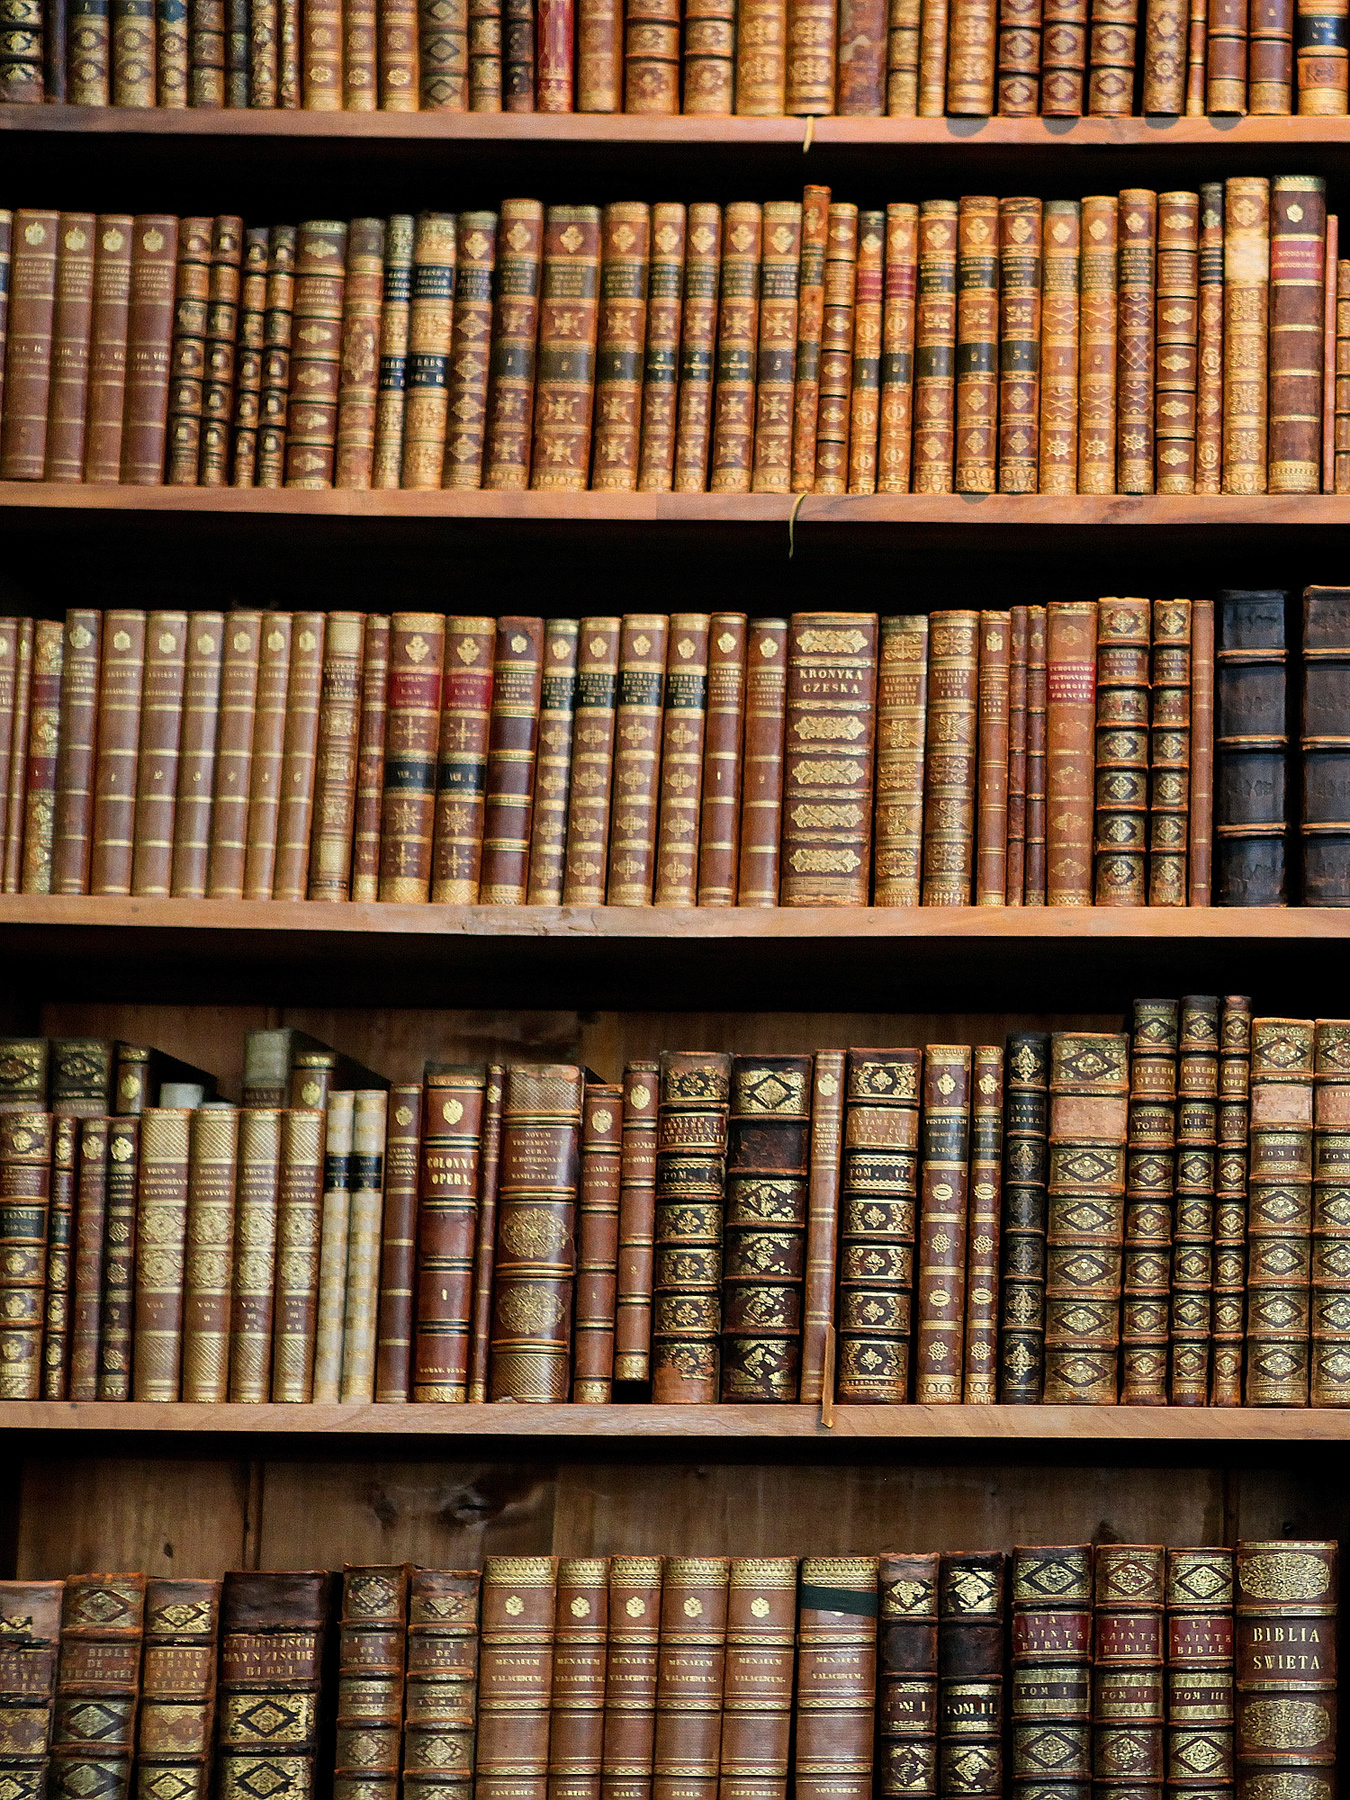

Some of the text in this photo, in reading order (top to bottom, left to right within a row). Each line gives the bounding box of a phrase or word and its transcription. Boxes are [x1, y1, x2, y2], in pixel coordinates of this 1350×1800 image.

[800, 669, 864, 681] KRONYKA
[1017, 1630, 1084, 1641] SAINTE
[1174, 1633, 1231, 1643] SAINTE
[1253, 1626, 1320, 1643] BIBLIA
[1022, 1640, 1075, 1651] BIBLE
[1177, 1644, 1225, 1654] BIBLE
[1020, 1686, 1049, 1696] TOM
[1101, 1691, 1127, 1700] TOM
